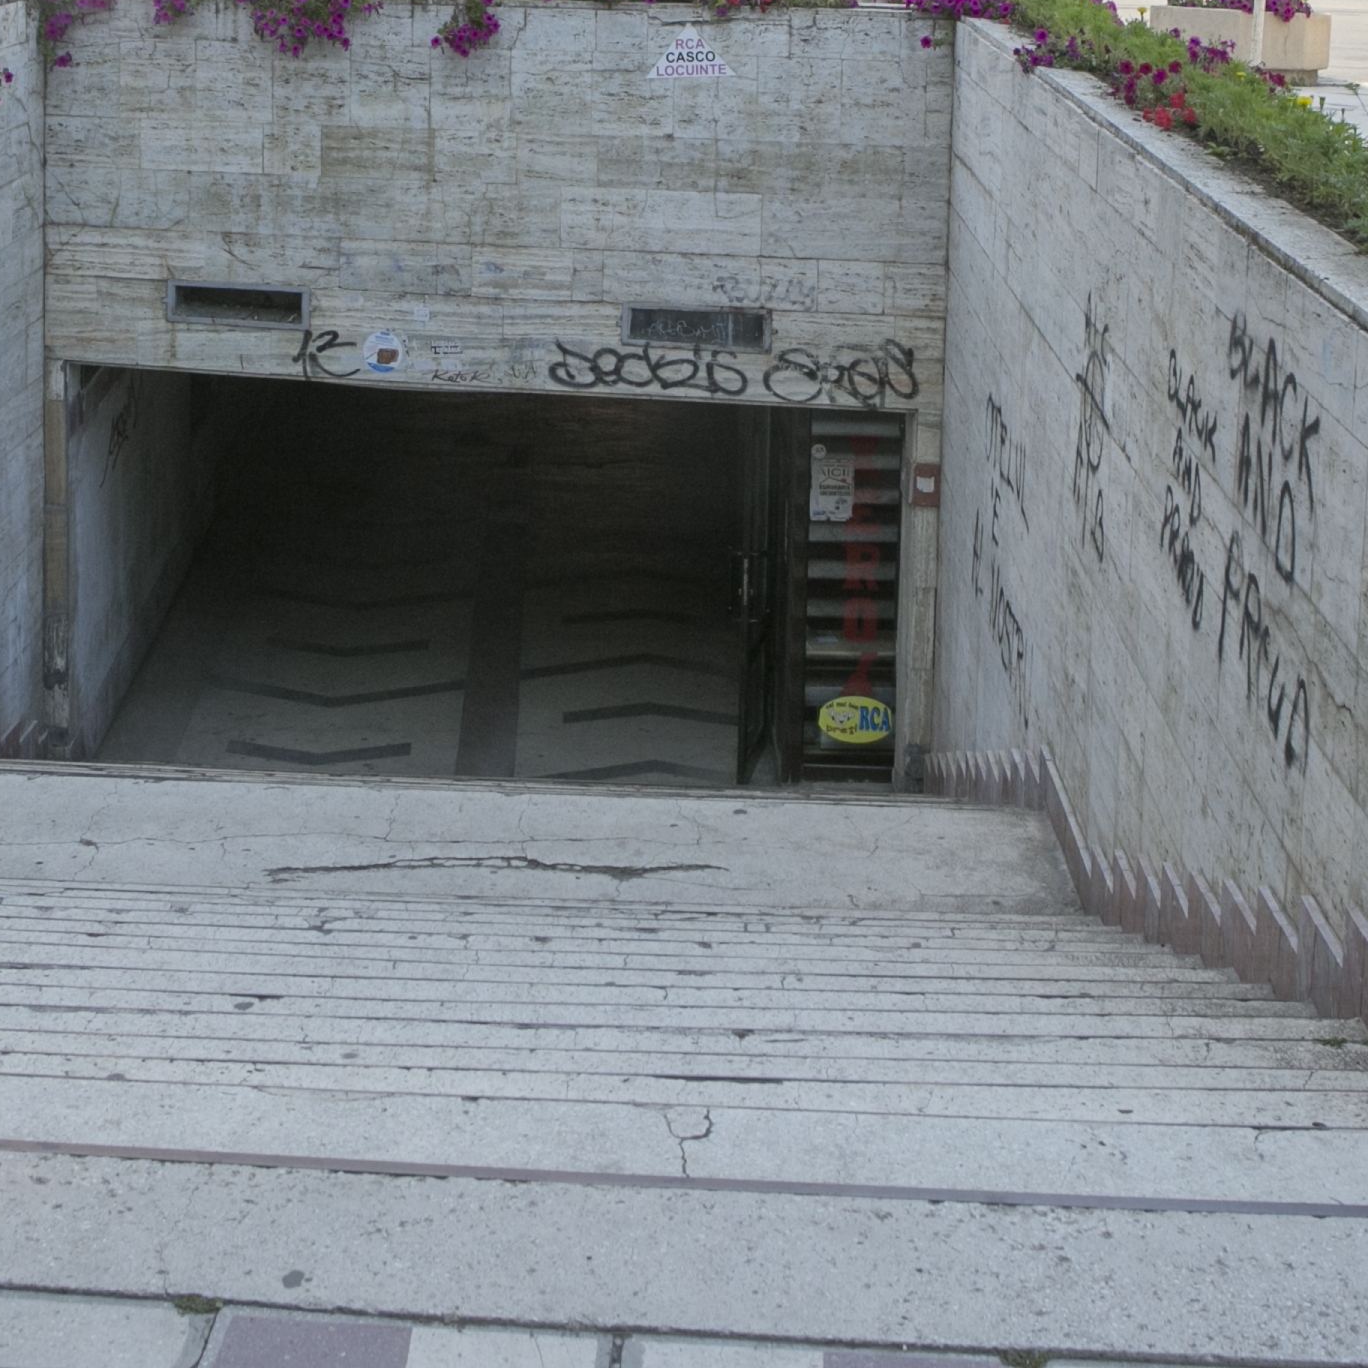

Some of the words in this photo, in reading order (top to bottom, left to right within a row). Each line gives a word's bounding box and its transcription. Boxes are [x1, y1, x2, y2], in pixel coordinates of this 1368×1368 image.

[675, 38, 705, 50] RCA
[665, 51, 716, 63] CASCO
[656, 64, 727, 77] LOCUINTE
[1168, 348, 1217, 464] BLACK
[1229, 311, 1320, 518] BLACK
[859, 705, 891, 732] RCA
